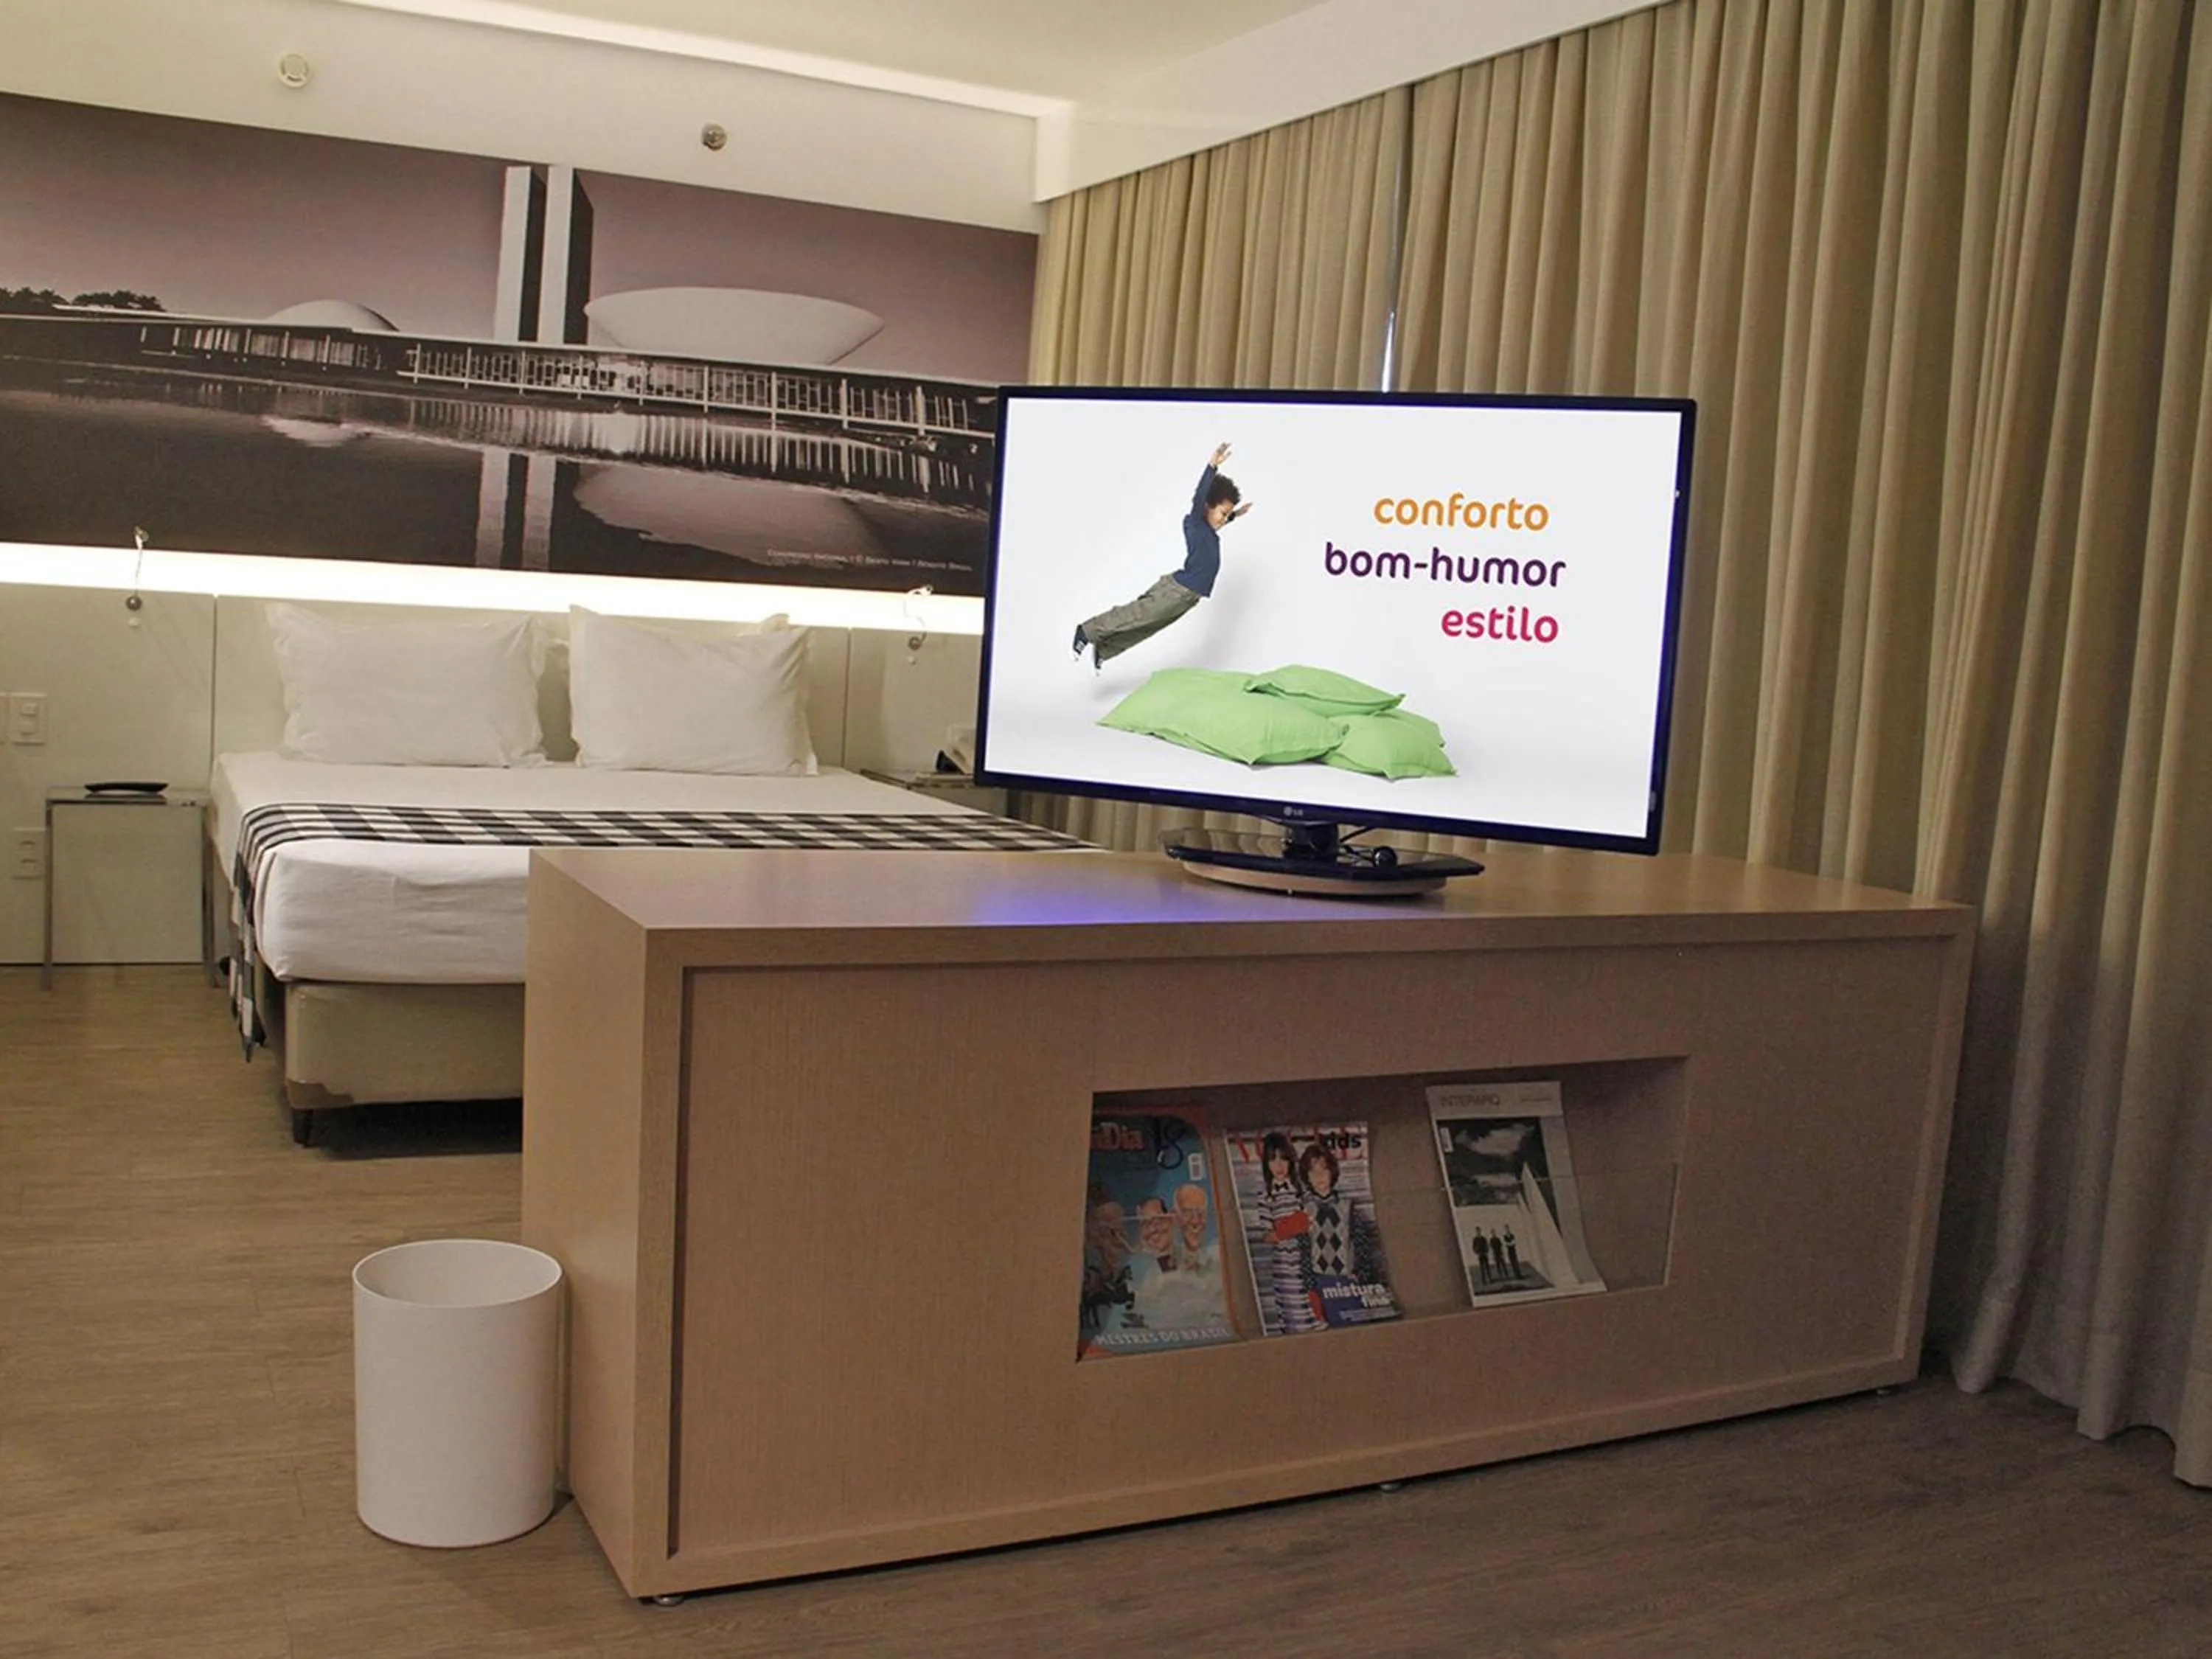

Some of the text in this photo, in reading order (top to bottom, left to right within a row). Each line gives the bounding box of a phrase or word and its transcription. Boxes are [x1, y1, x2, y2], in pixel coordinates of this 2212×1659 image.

[1374, 492, 1549, 531] conforto
[1324, 541, 1567, 587] bom-humor
[1441, 605, 1559, 643] estilo
